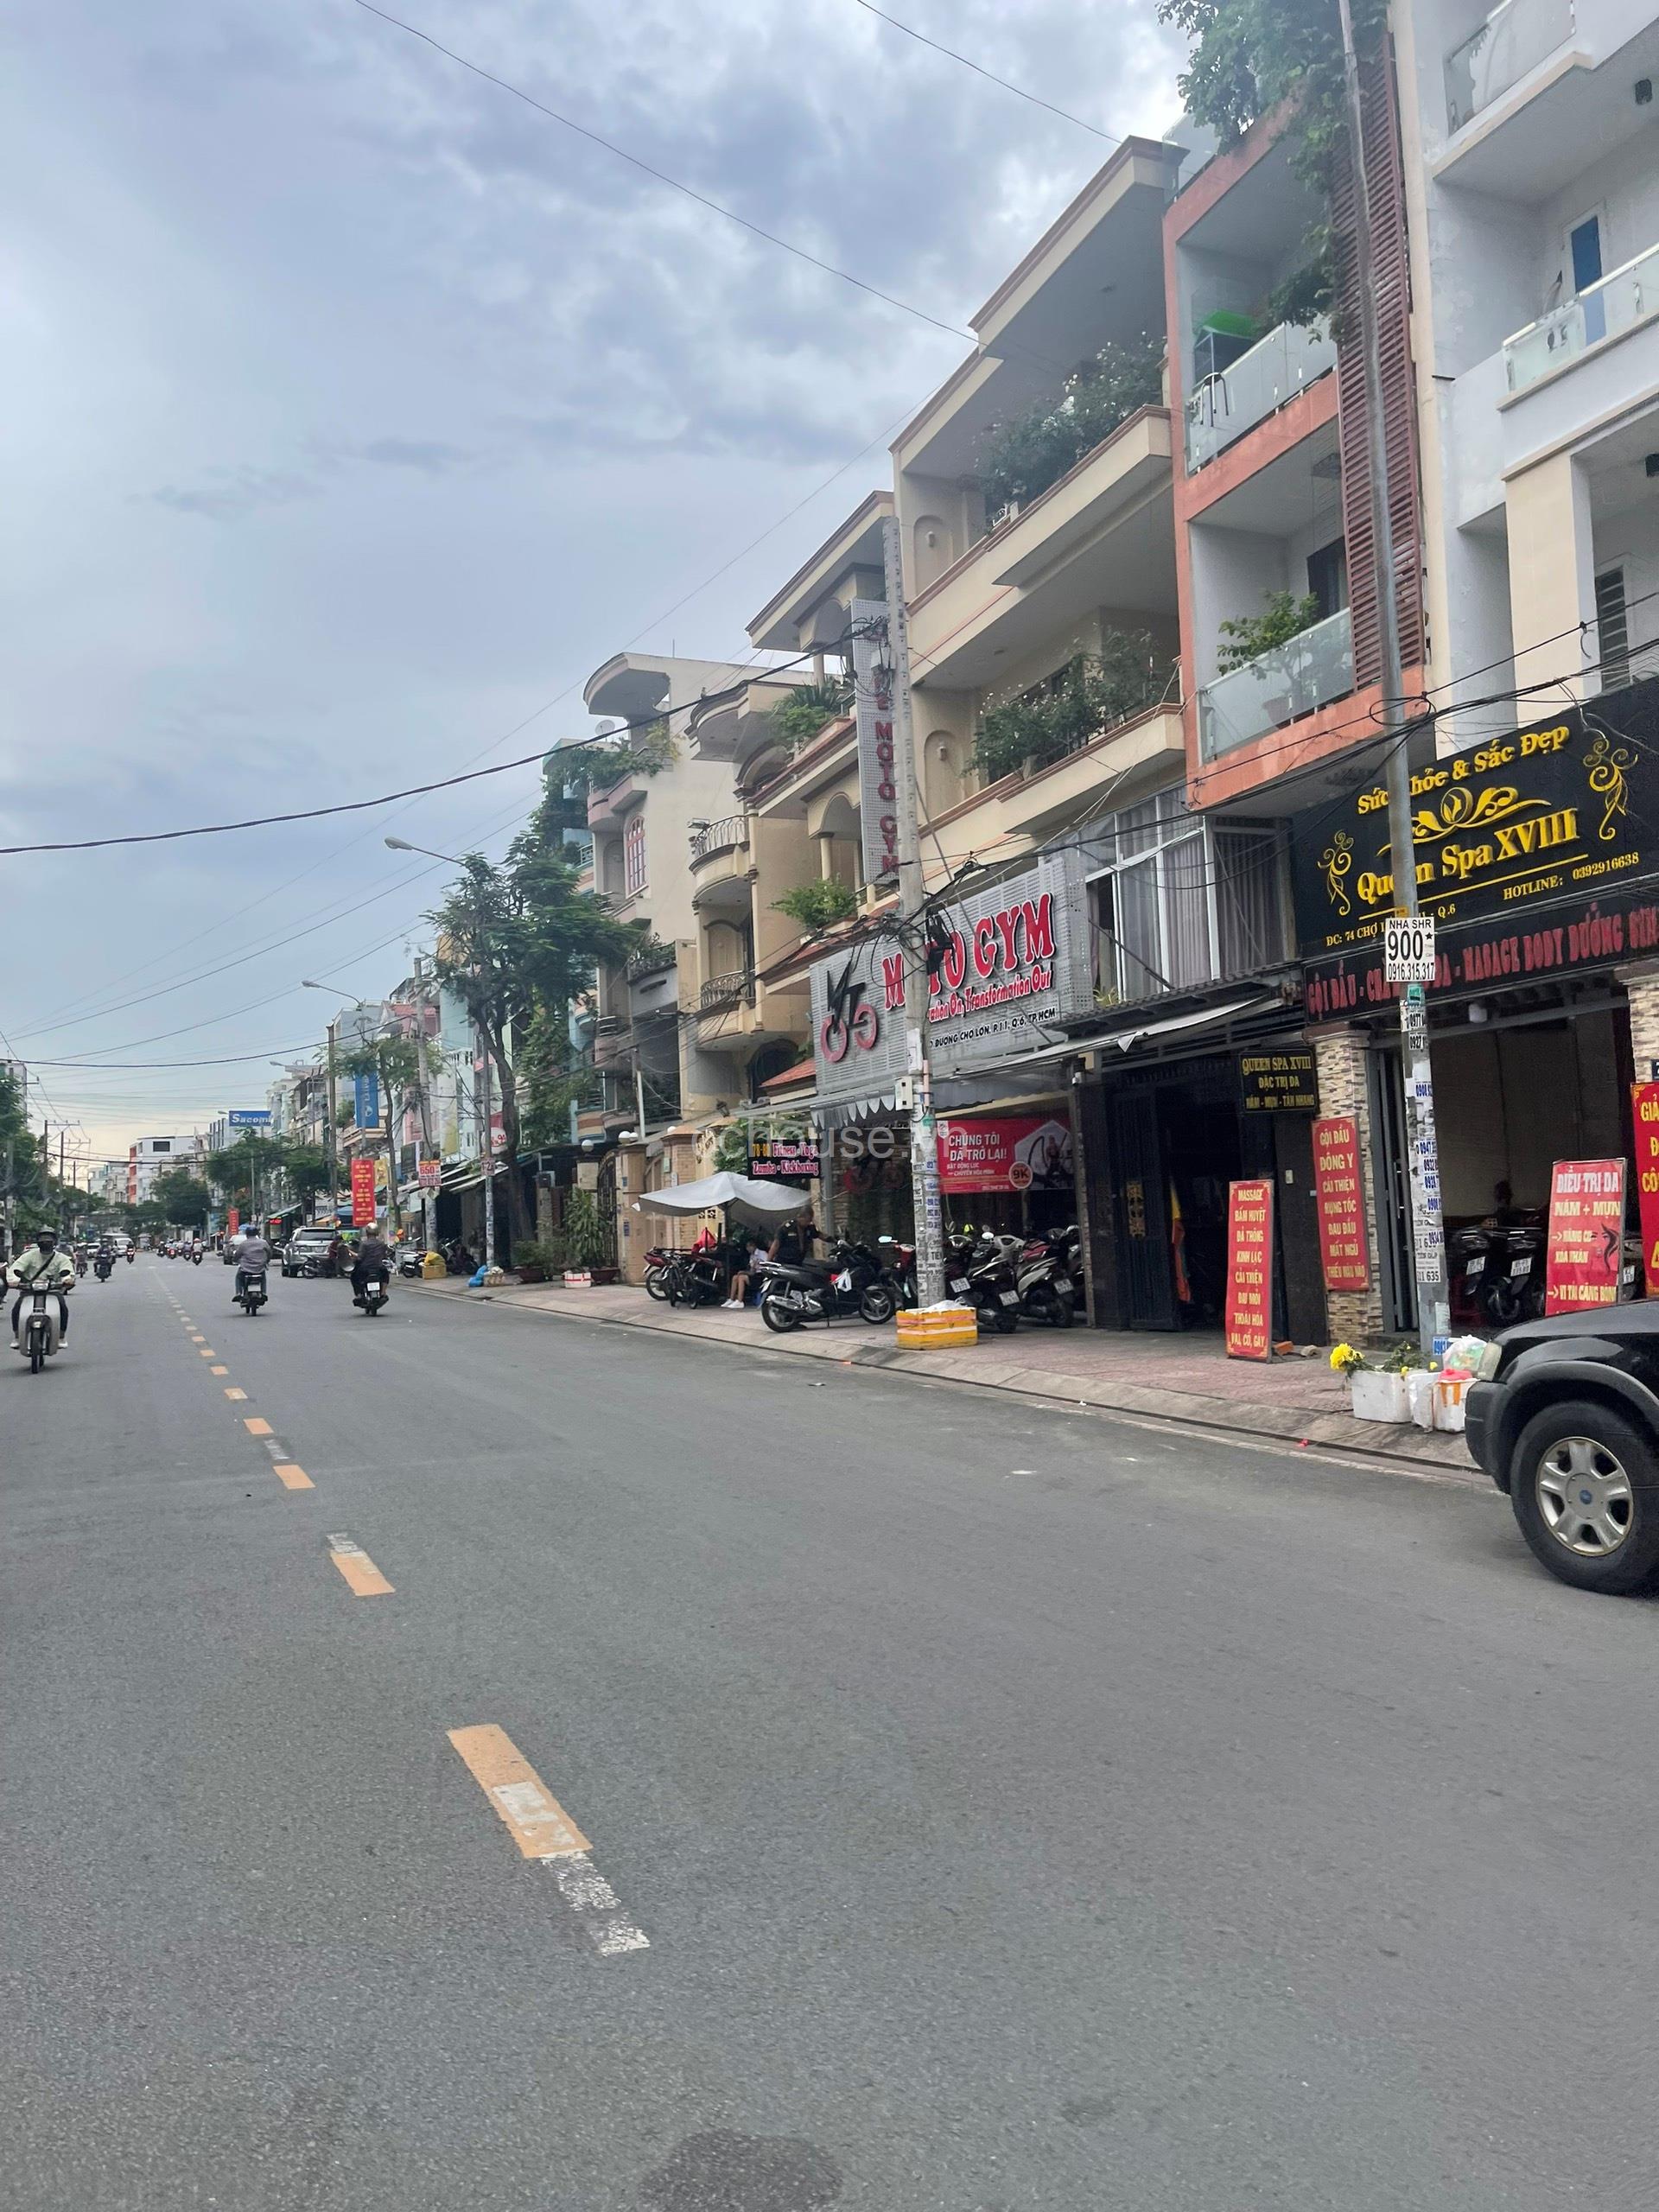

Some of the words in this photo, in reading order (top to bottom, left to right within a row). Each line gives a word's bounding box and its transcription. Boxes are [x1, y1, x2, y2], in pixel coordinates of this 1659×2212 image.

[1410, 766, 1450, 797] hỏe
[1452, 759, 1471, 781] &
[1473, 737, 1516, 773] Sắc
[1519, 725, 1570, 757] Đẹp
[1357, 859, 1435, 906] Qun
[1441, 842, 1494, 880] Spa
[1493, 807, 1581, 861] XVIII
[1572, 851, 1640, 880] 0392916638
[1503, 874, 1563, 900] HOTLINE:
[1389, 918, 1409, 930] NHA
[1411, 918, 1432, 930] SHR
[973, 892, 1056, 979] GYM
[1344, 930, 1355, 942] 74
[1388, 930, 1424, 962] 900
[1523, 927, 1565, 971] BODY
[1388, 962, 1435, 981] 0916.315.317
[964, 973, 1031, 1013] Transformation
[1272, 1057, 1289, 1071] SPA
[1289, 1056, 1312, 1071] XVIII
[231, 1113, 271, 1123] Sacom
[948, 1132, 982, 1147] CHÚNG
[984, 1131, 1001, 1145] TÔI
[950, 1147, 963, 1161] ĐÃ
[780, 1160, 819, 1176] Kickboxing
[1603, 1172, 1619, 1192] DA
[1642, 1166, 1659, 1192] CÔ
[1237, 1188, 1264, 1202] MASSAGE
